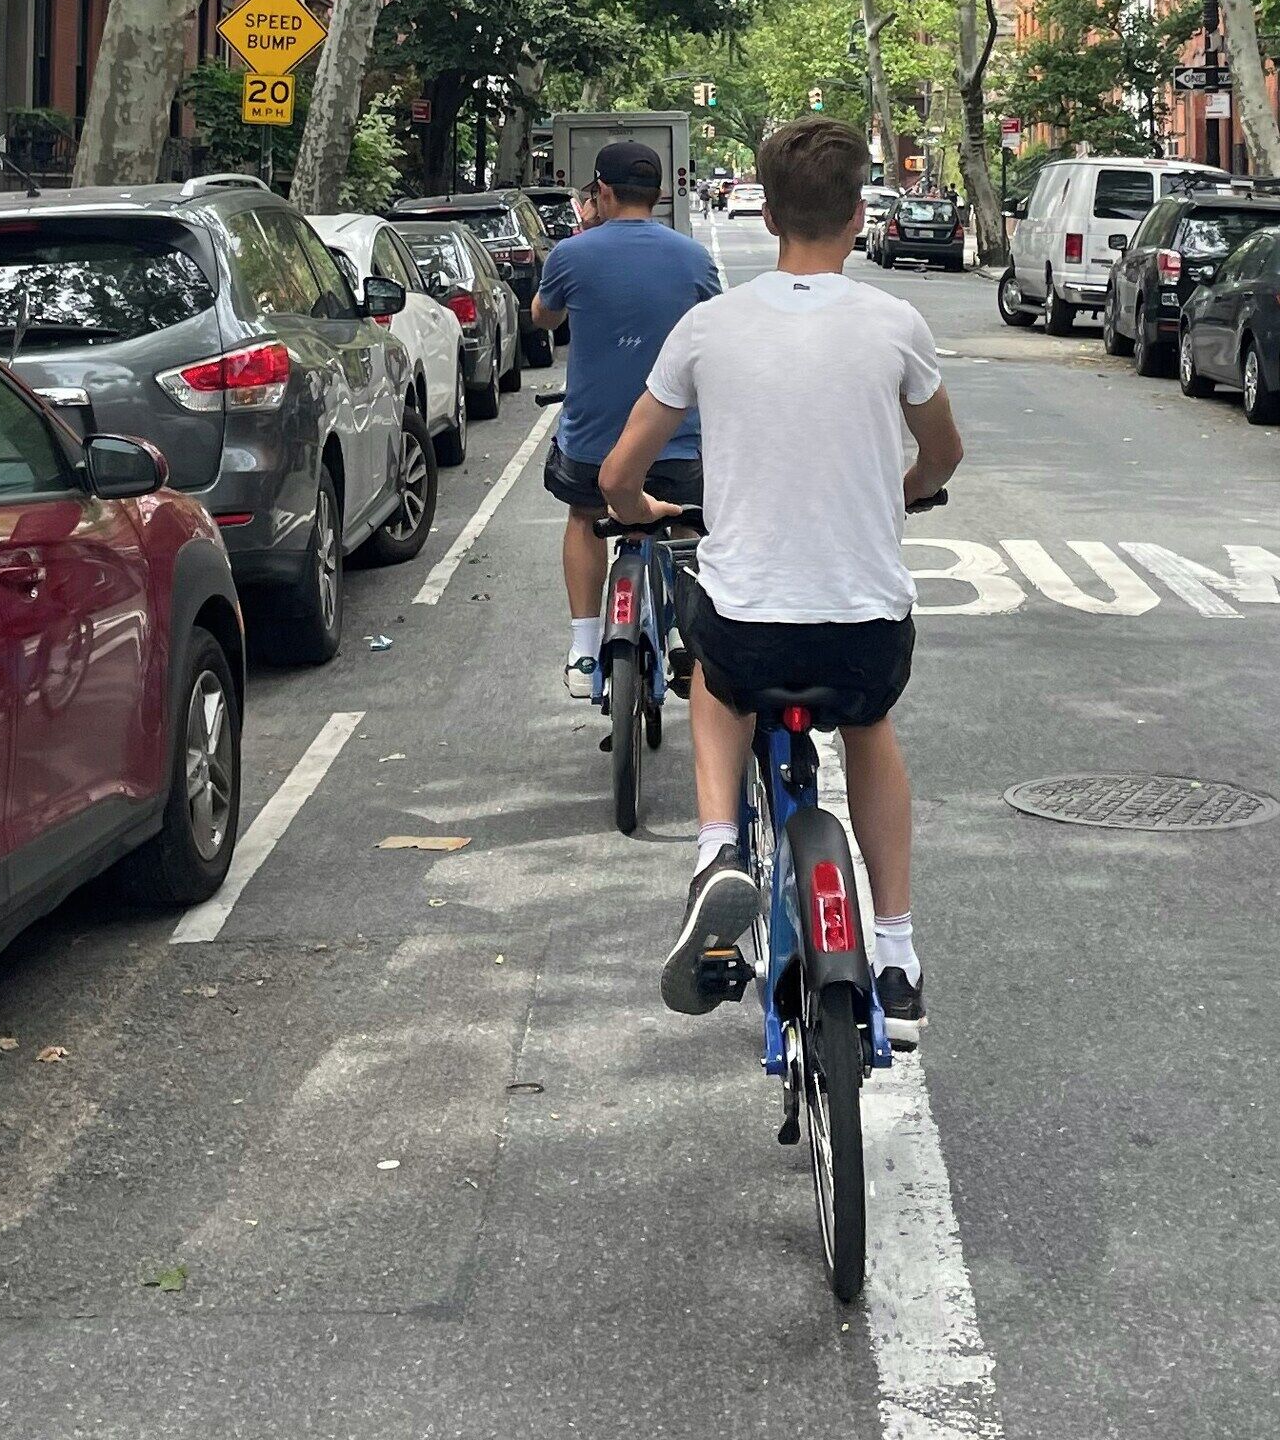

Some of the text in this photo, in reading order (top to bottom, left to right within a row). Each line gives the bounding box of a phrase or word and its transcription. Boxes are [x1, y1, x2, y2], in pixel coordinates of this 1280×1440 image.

[245, 13, 302, 31] SPEED
[247, 34, 297, 51] BUMP
[248, 80, 290, 104] 20
